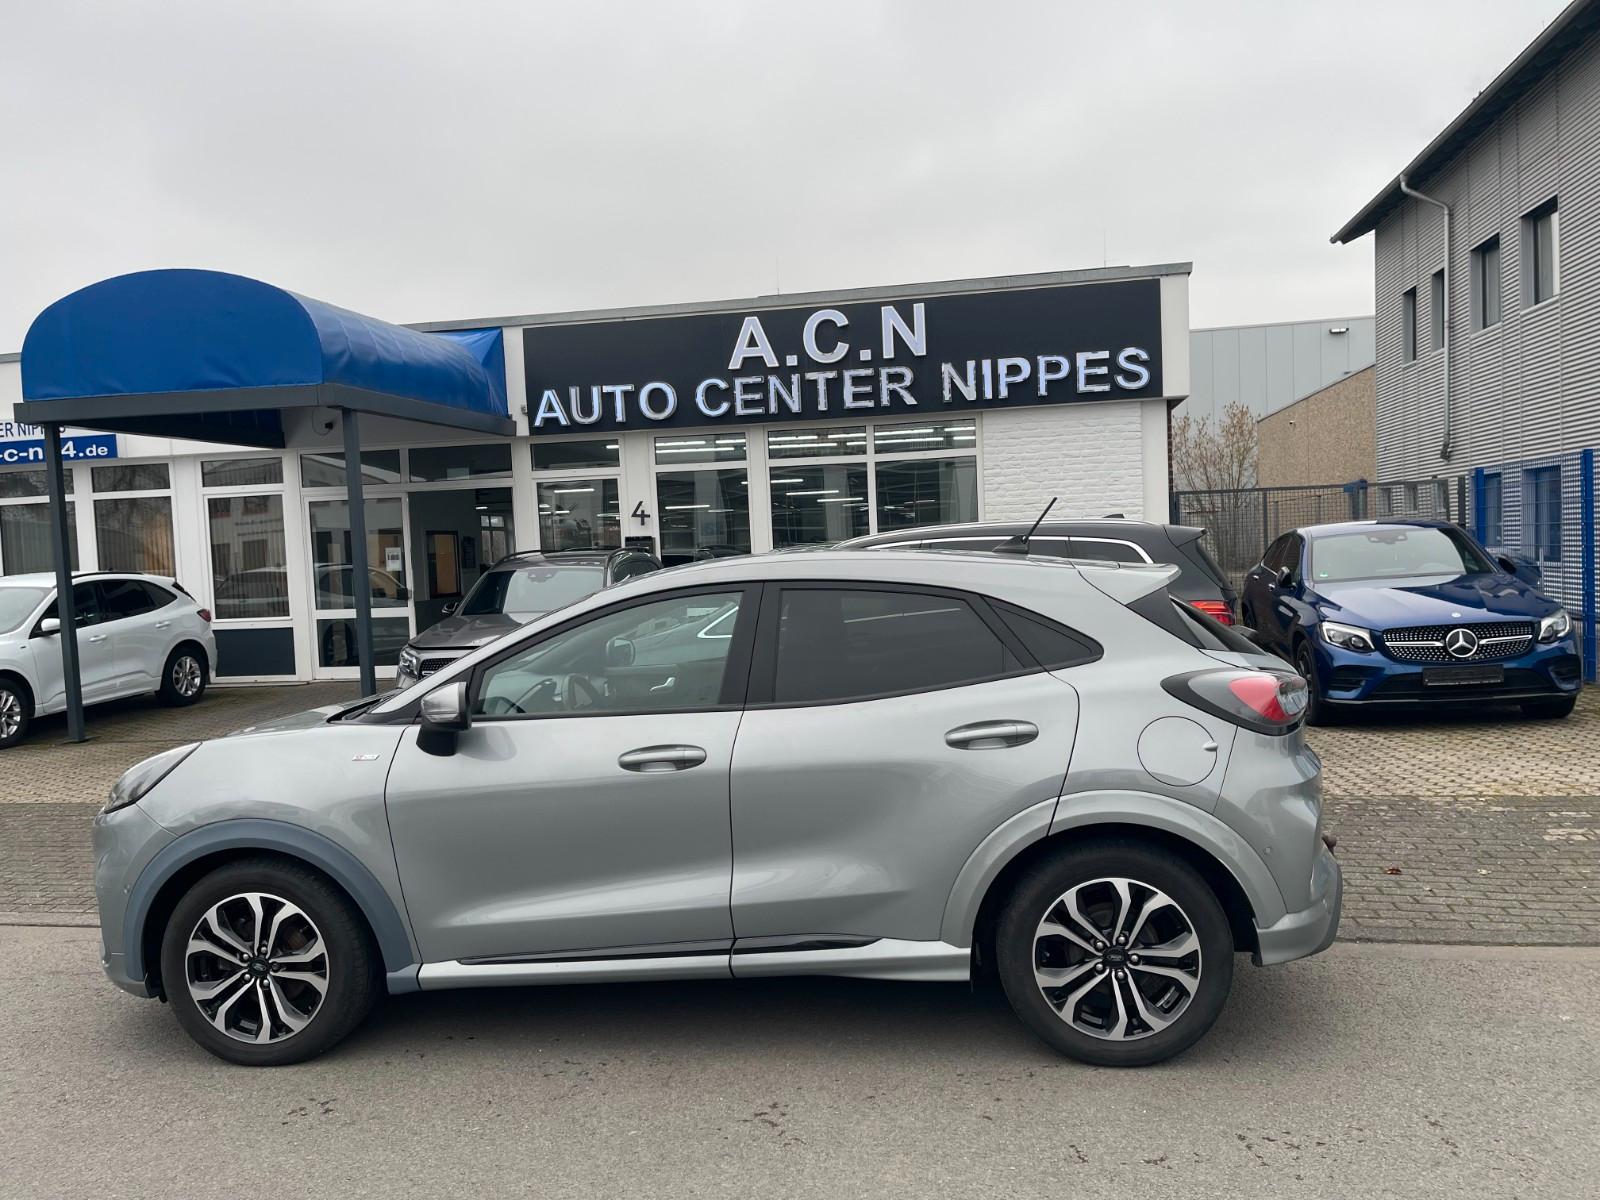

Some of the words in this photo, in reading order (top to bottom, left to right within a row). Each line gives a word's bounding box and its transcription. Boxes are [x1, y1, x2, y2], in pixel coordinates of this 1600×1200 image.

[727, 302, 927, 370] A.C.N
[533, 381, 678, 428] AUTO
[695, 367, 918, 417] CENTER
[941, 346, 1151, 403] NIPPES
[631, 500, 650, 526] 4
